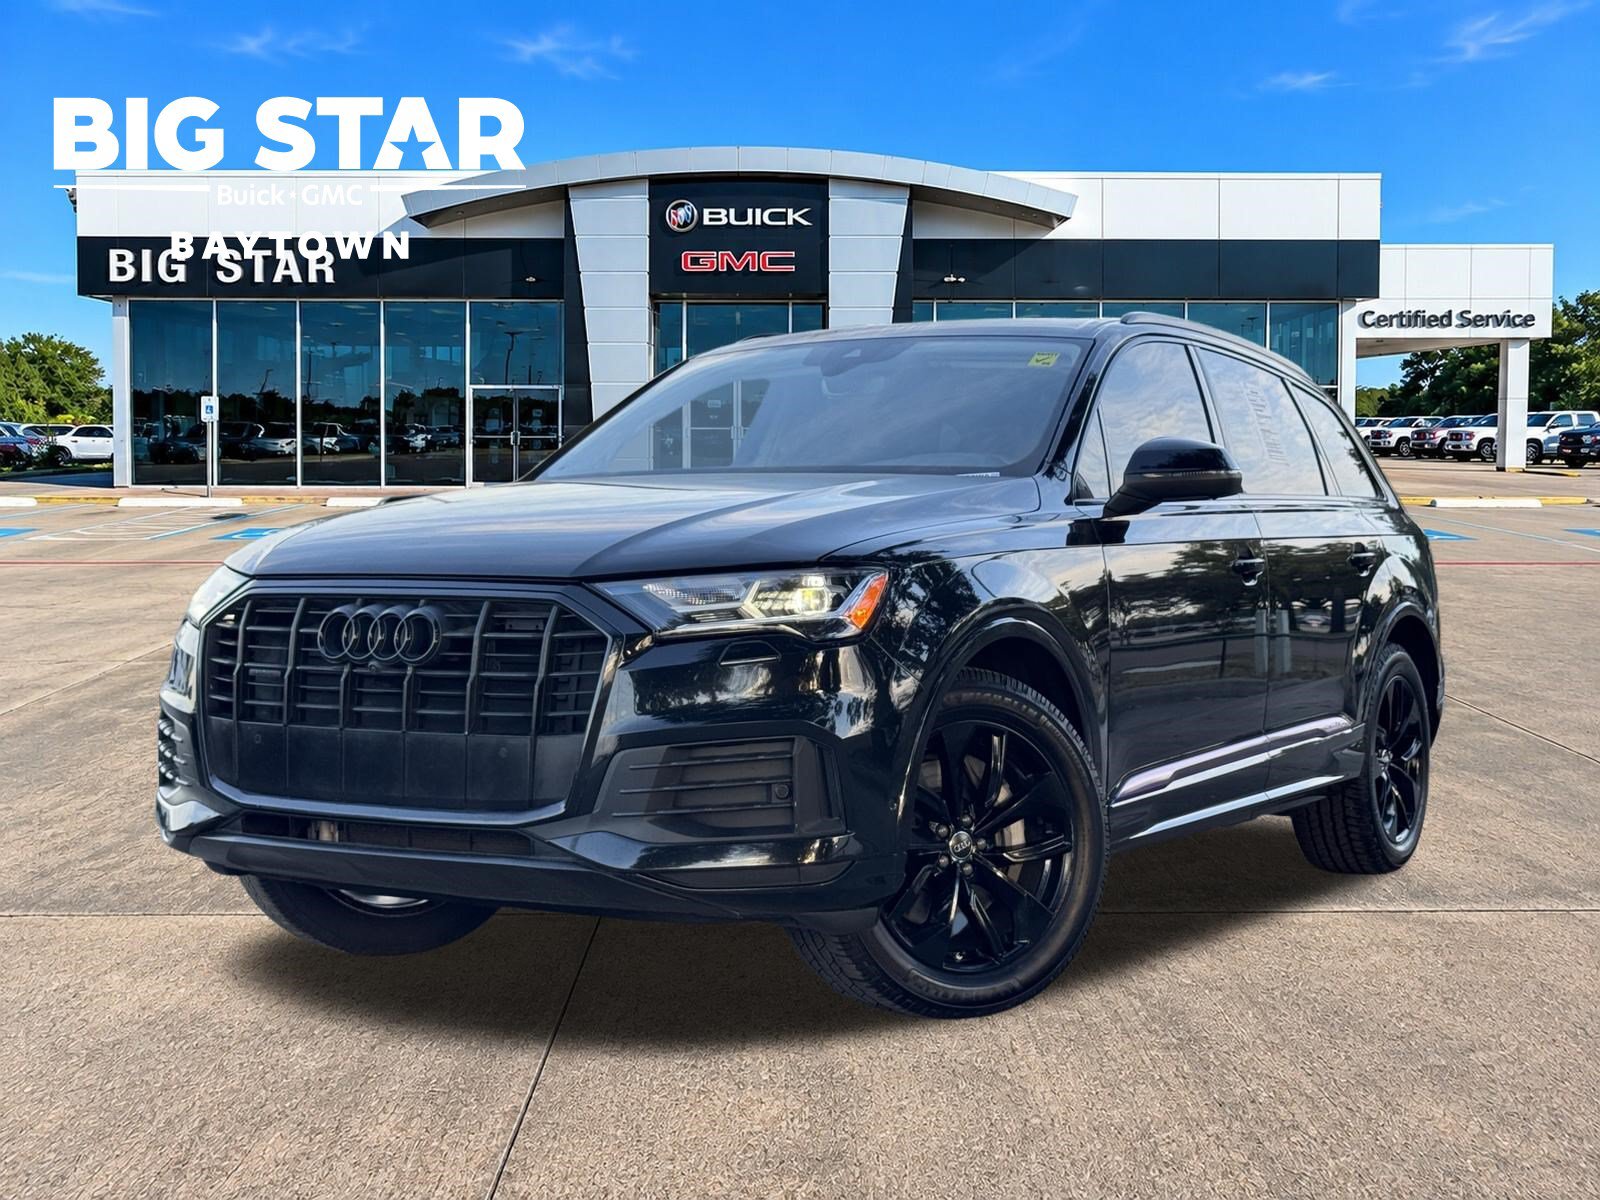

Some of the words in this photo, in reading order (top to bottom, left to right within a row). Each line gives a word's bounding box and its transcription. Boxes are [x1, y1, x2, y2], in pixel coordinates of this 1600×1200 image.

[702, 207, 813, 226] BUICK
[108, 249, 187, 283] BIG
[216, 249, 336, 283] STAR
[681, 251, 796, 272] GMC
[1360, 309, 1453, 328] Certified
[1455, 309, 1536, 328] Service
